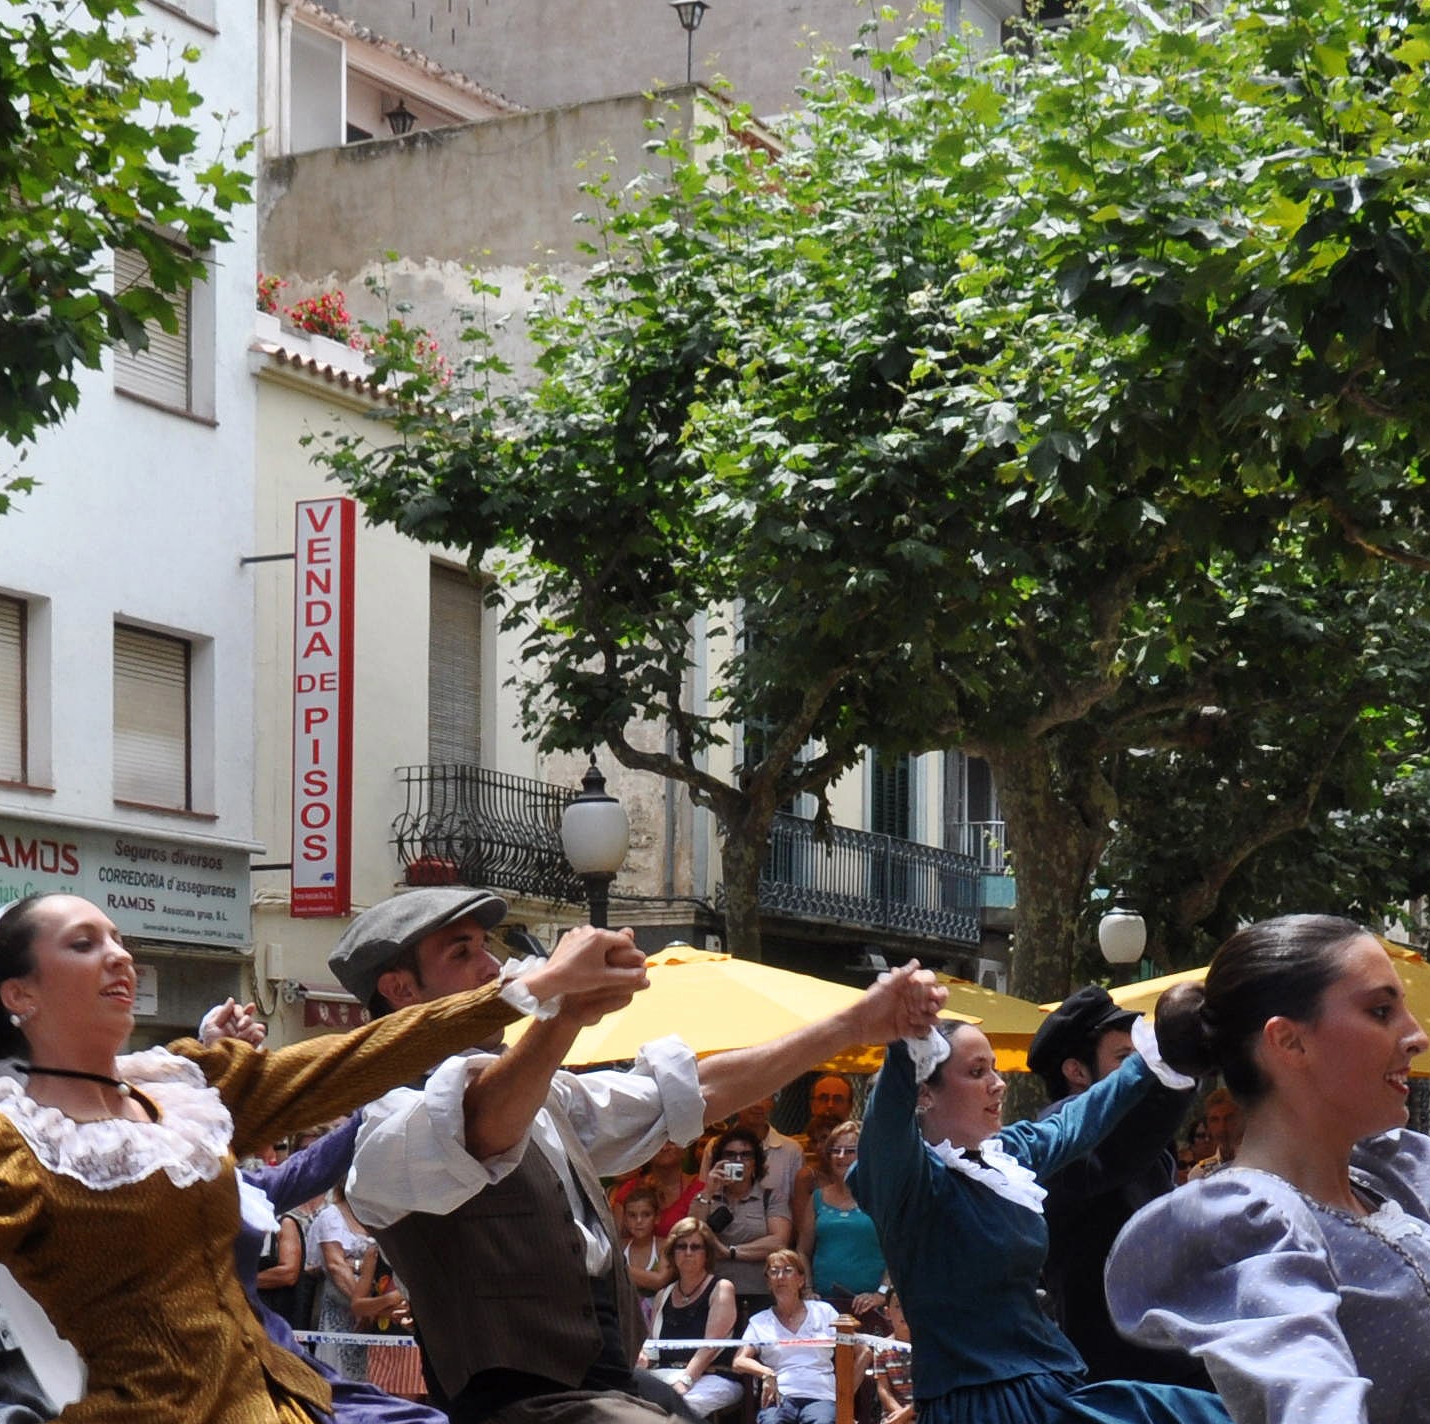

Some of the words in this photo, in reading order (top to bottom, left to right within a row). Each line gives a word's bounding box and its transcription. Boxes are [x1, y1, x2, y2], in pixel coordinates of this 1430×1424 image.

[302, 506, 333, 659] VENDA
[297, 672, 337, 694] DE
[300, 707, 331, 862] PISOS
[114, 840, 168, 862] Seguros
[171, 850, 224, 871] diversos
[98, 866, 165, 890] CORREDORIA
[107, 894, 156, 912] RAMOS
